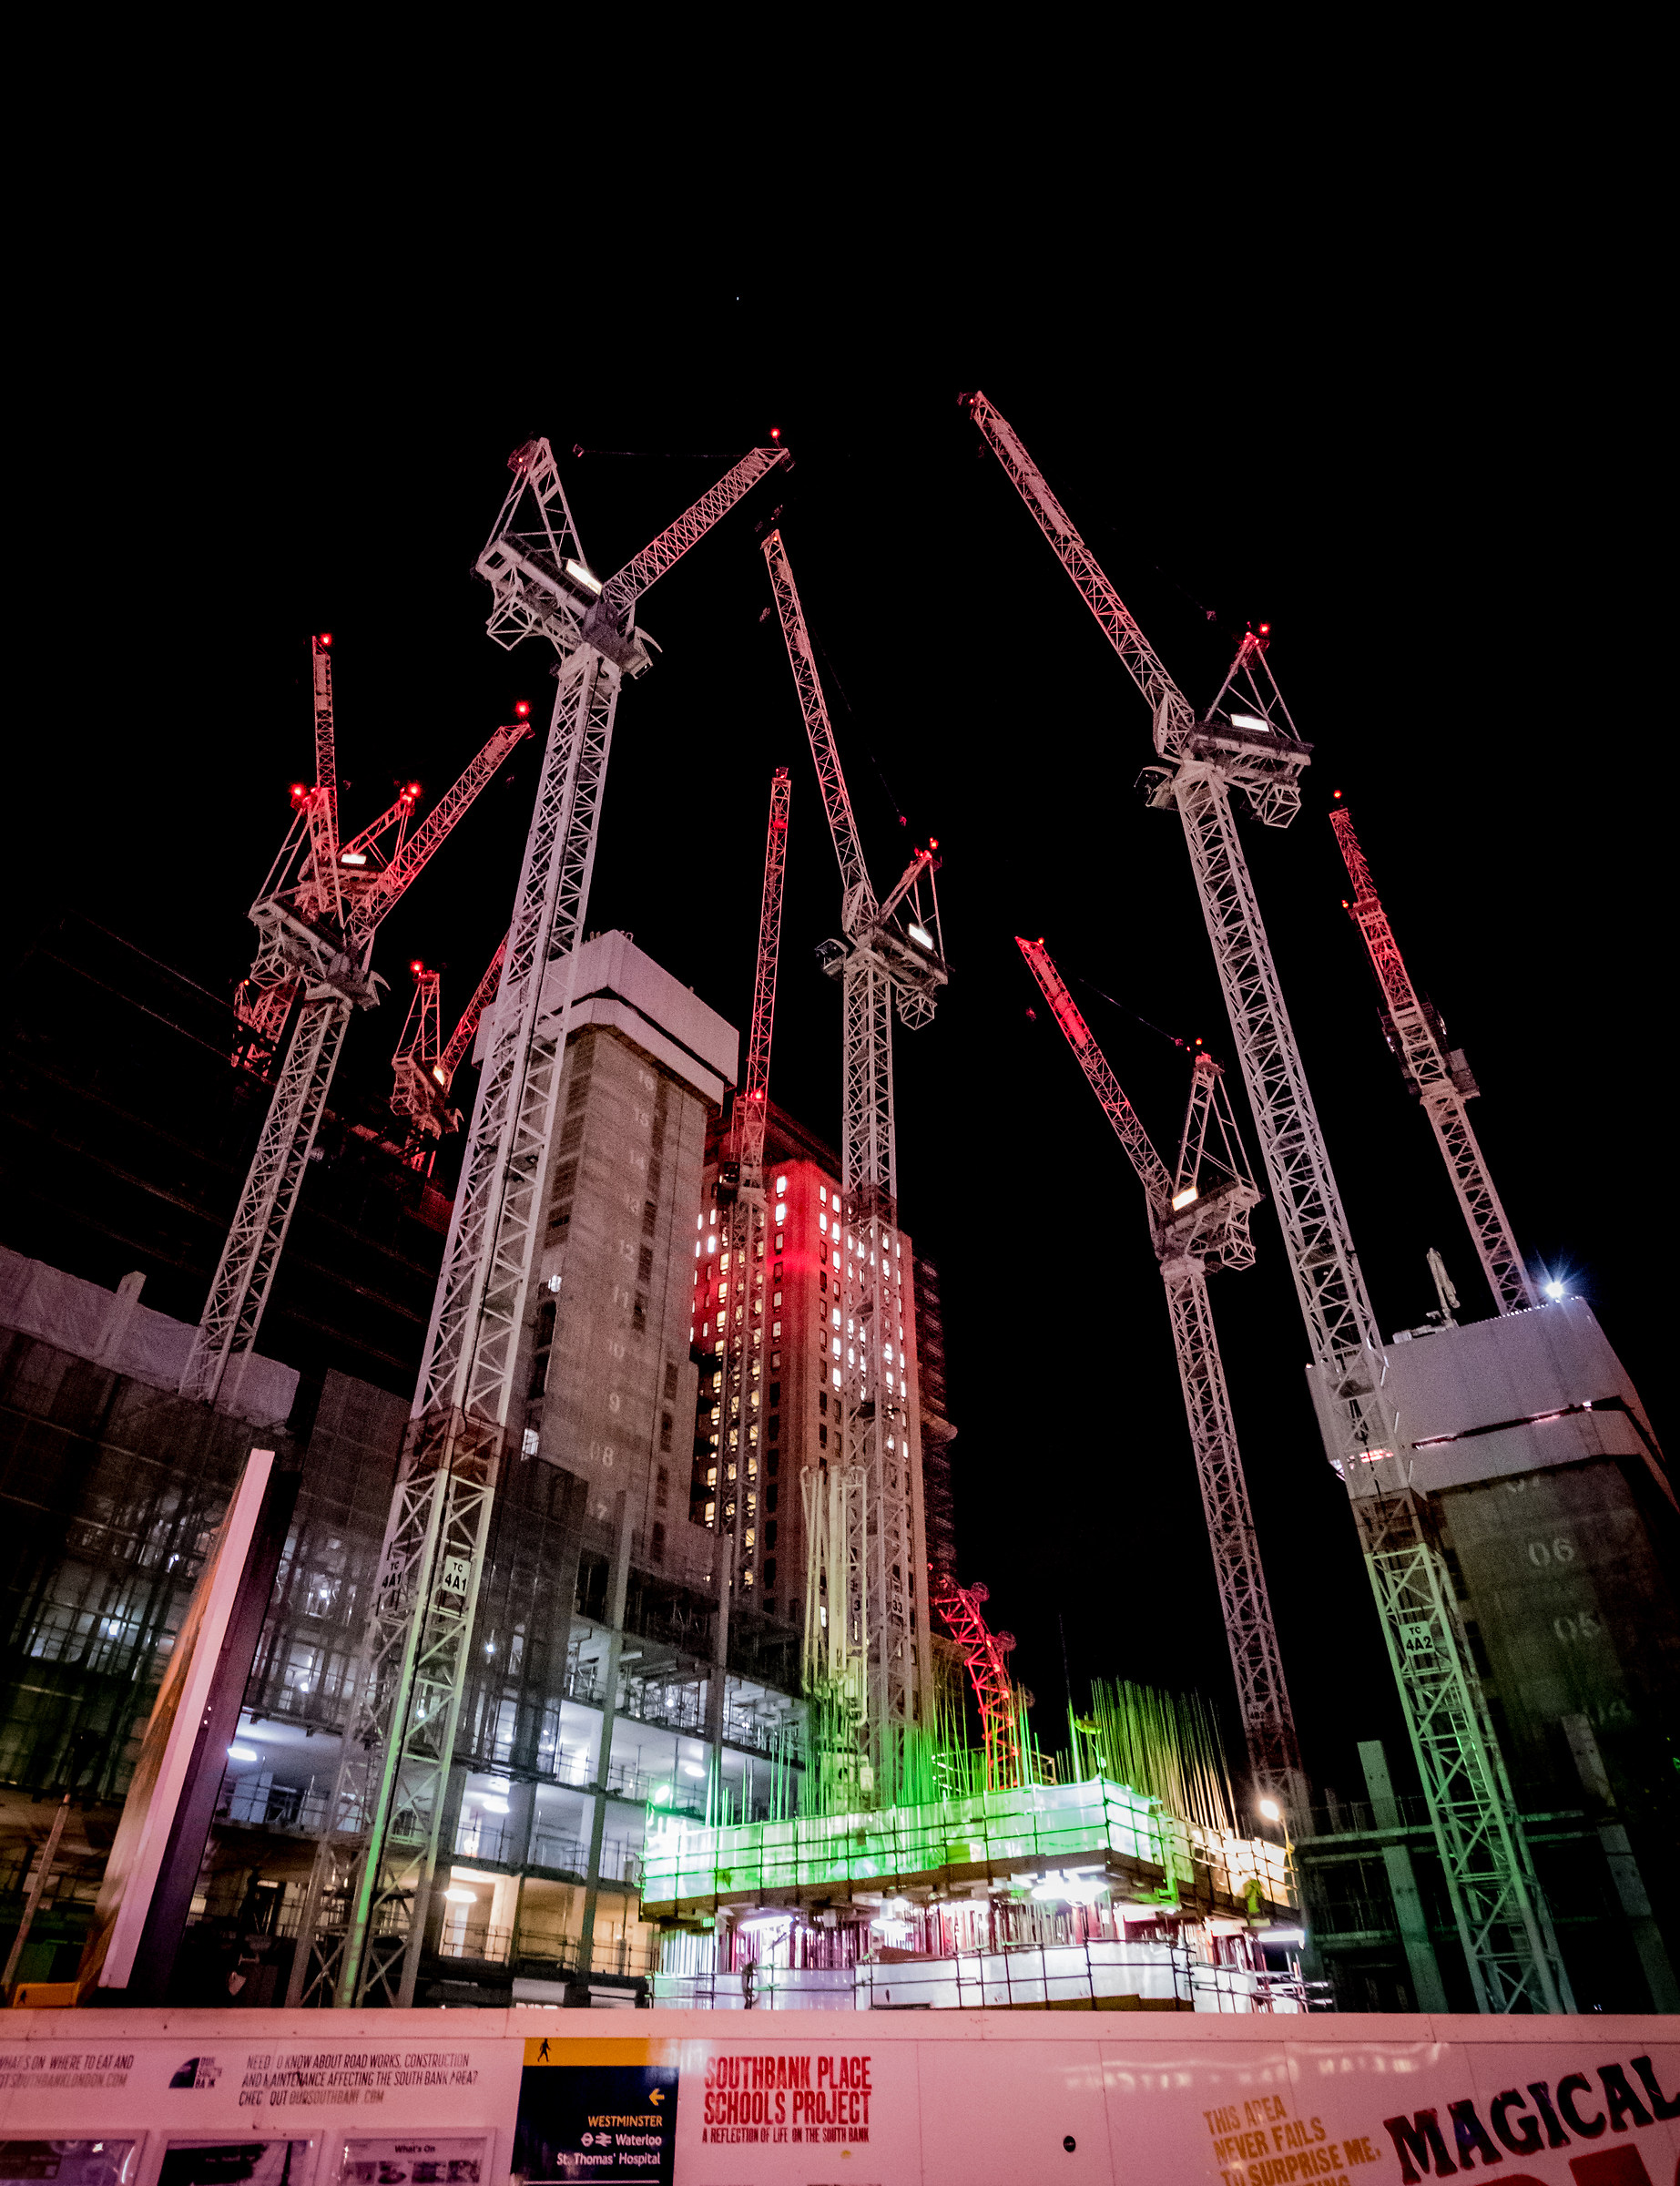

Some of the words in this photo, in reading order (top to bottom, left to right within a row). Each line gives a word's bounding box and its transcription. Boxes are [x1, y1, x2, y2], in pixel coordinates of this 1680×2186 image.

[1528, 1537, 1575, 1566] 06
[390, 1560, 399, 1571] TC
[453, 1561, 463, 1573] TC
[382, 1571, 402, 1588] 4A1
[444, 1572, 467, 1592] 4A1
[1409, 1626, 1421, 1635] TC
[1406, 1636, 1432, 1651] 4A2
[50, 2055, 82, 2069] WHERE
[84, 2055, 96, 2069] TO
[96, 2055, 113, 2069] EAT
[113, 2055, 134, 2069] AND
[247, 2055, 270, 2069] NEED
[285, 2054, 311, 2069] KNOW
[312, 2054, 342, 2069] ABOUT
[343, 2054, 368, 2069] ROAD
[404, 2054, 470, 2069] CONSTRUCTION
[241, 2072, 262, 2088] AND
[327, 2071, 374, 2087] AFFECTING
[376, 2071, 392, 2086] THE
[393, 2070, 423, 2086] SOUTH
[424, 2070, 448, 2086] BANK
[704, 2056, 810, 2089] SOUTHBANK
[817, 2056, 872, 2089] PLACE
[195, 2078, 216, 2089] BAK
[239, 2090, 267, 2106] CHEC
[270, 2090, 288, 2106] OUT
[704, 2090, 787, 2125] SCHOOLS
[792, 2090, 871, 2125] PROJECT
[587, 2115, 663, 2128] WESTMINSTER
[1202, 2105, 1241, 2136] THIS
[1382, 2055, 1680, 2186] MAGICAL
[615, 2133, 663, 2147] Waterloo
[702, 2127, 708, 2143] A
[710, 2127, 759, 2143] REFLECTION
[760, 2127, 770, 2143] OF
[773, 2127, 788, 2143] LIFE
[791, 2127, 802, 2143] ON
[805, 2127, 820, 2143] THE
[822, 2127, 847, 2143] SOUTH
[849, 2127, 870, 2143] BANK
[1212, 2130, 1270, 2166] NEVER
[1270, 2117, 1327, 2152] FAILS
[394, 2145, 422, 2153] What's
[574, 2152, 616, 2166] Thomas'
[618, 2151, 661, 2167] Hospital
[1247, 2143, 1344, 2186] SURPRISE
